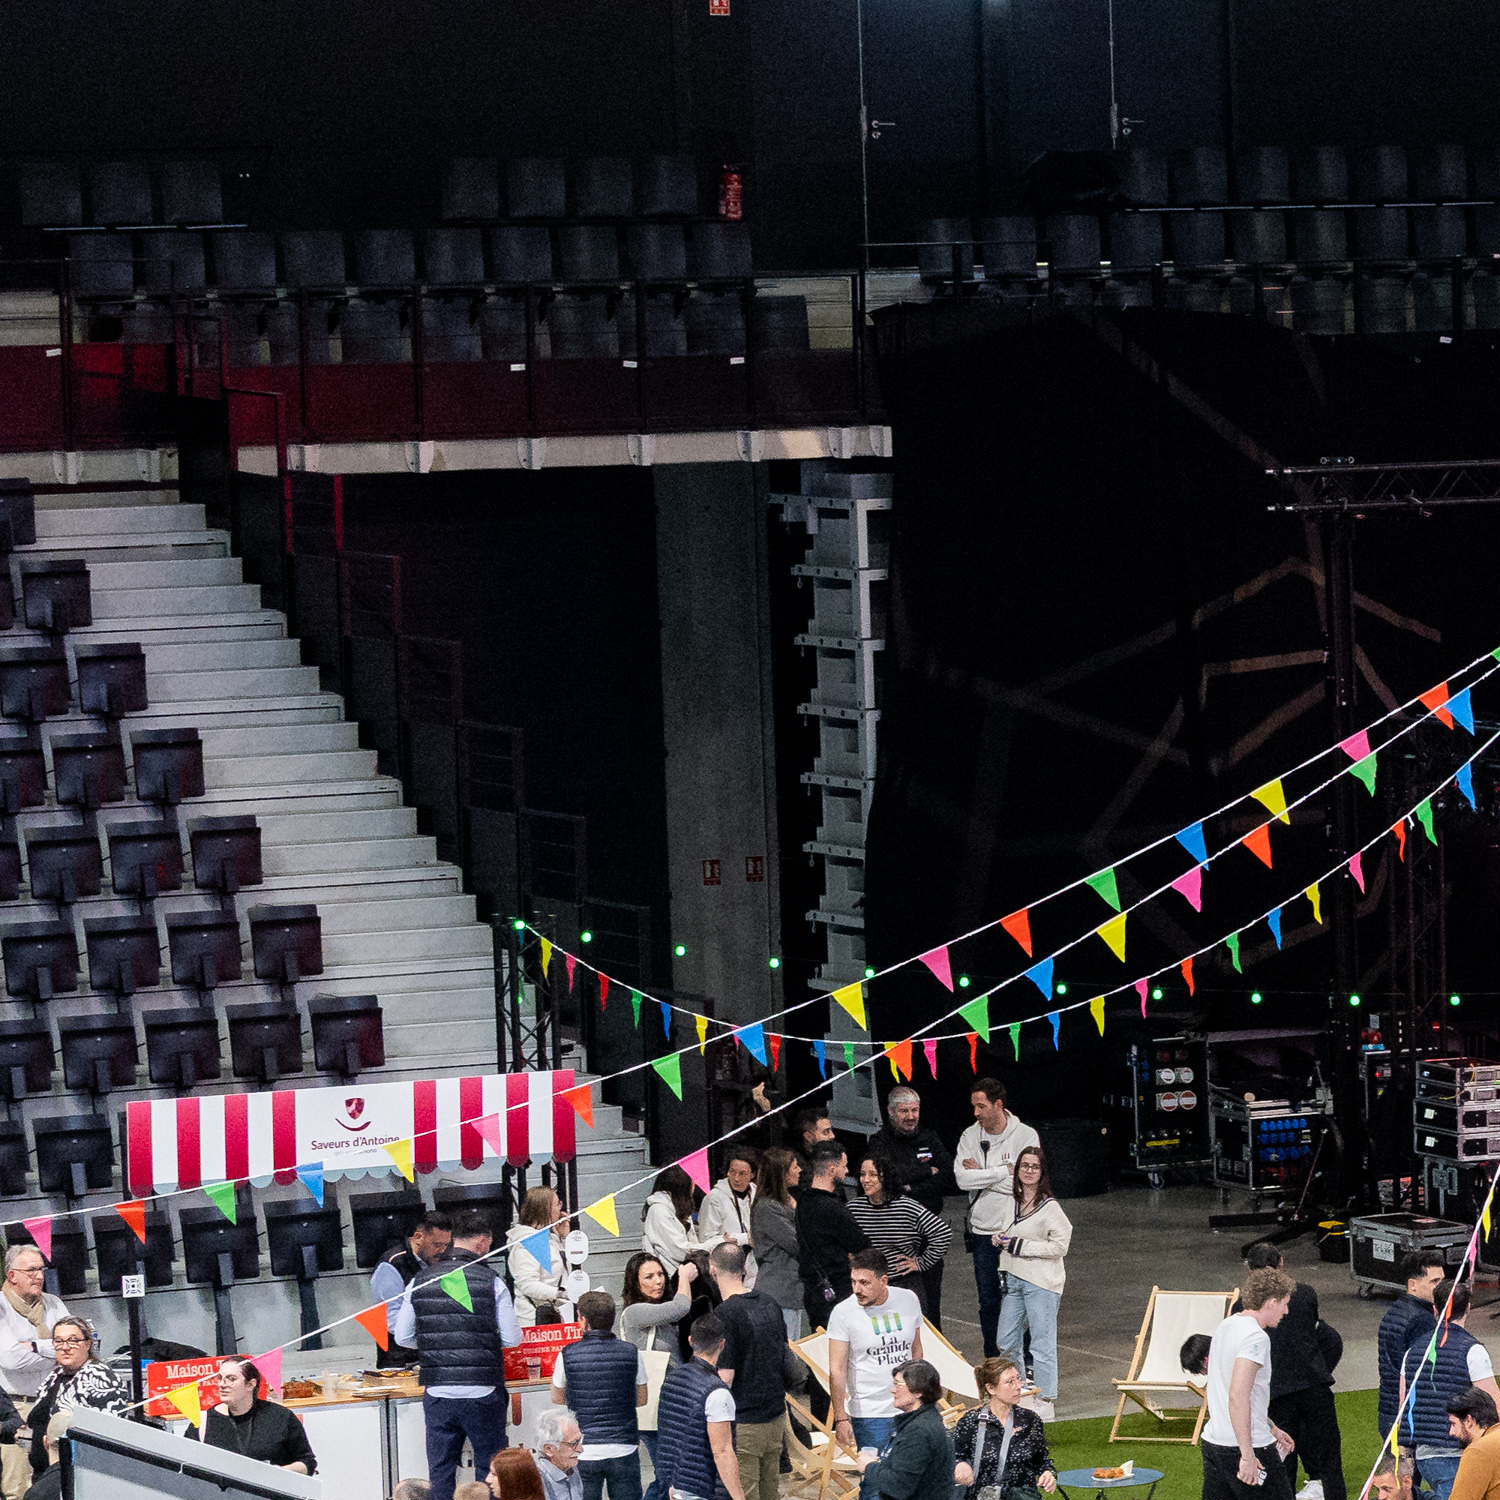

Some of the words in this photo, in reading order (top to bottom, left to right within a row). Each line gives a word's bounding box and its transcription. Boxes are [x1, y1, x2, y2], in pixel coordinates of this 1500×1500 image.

[311, 1140, 350, 1150] Saveurs
[353, 1135, 400, 1147] d'Antoine
[522, 1329, 562, 1343] Maison
[881, 1336, 898, 1346] La
[866, 1340, 911, 1356] Grande
[877, 1353, 909, 1365] Place
[166, 1364, 214, 1379] Maison
